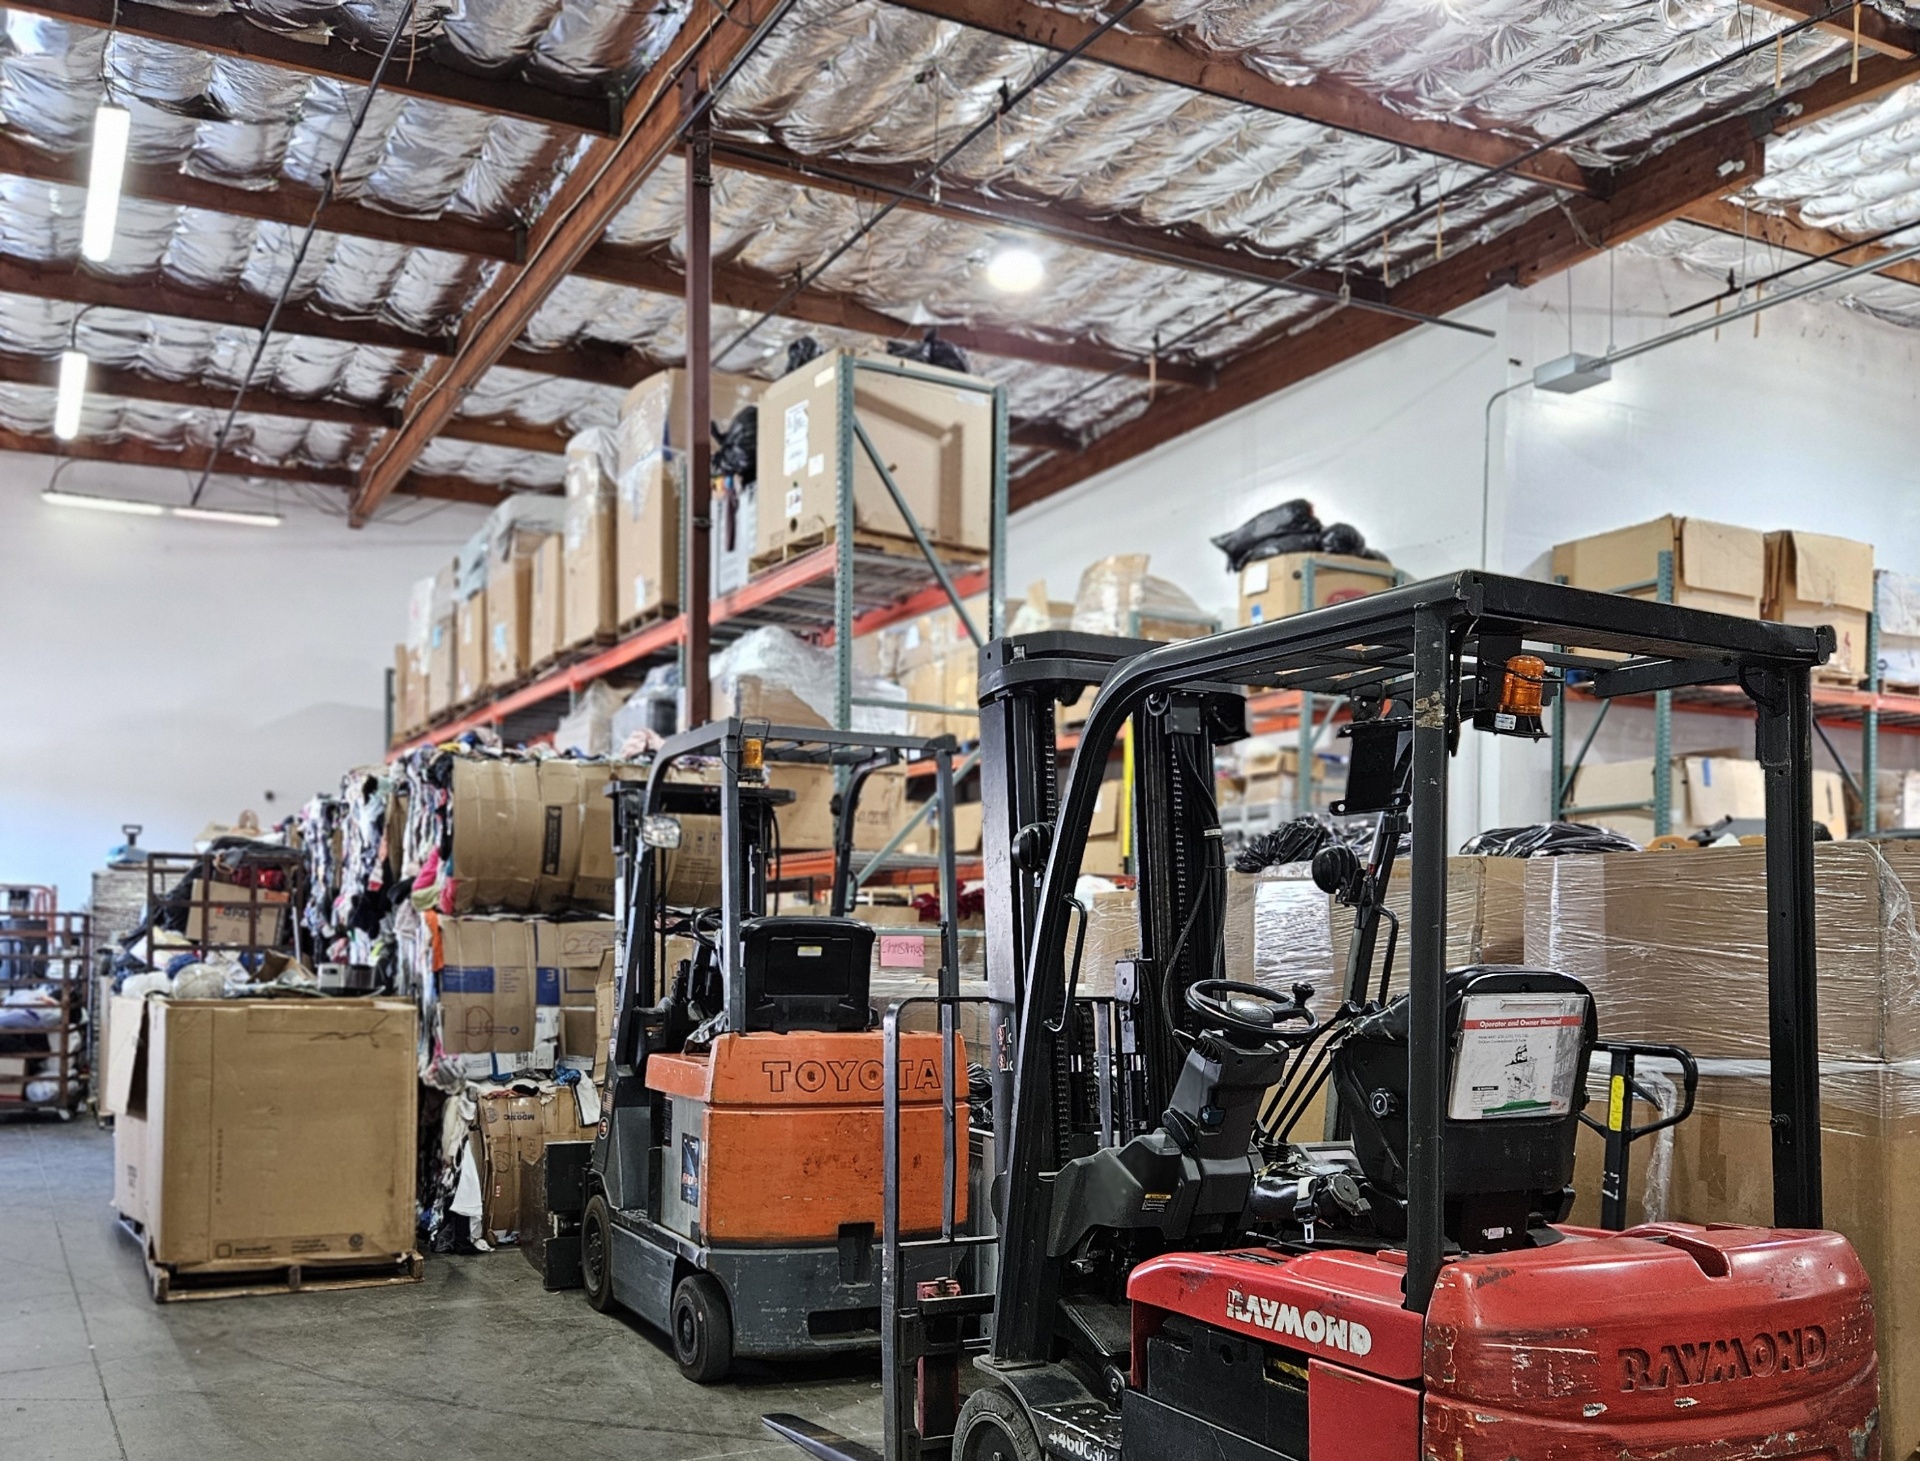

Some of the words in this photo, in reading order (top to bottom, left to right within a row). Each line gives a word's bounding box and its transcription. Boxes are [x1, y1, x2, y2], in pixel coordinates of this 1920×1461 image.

[1480, 1020, 1507, 1029] Operator
[1520, 1019, 1540, 1027] Owner
[1541, 1018, 1563, 1026] Manual
[762, 1060, 942, 1093] TOYOTA
[1226, 1288, 1372, 1357] RAYMOND
[1617, 1325, 1827, 1393] RAYMOND
